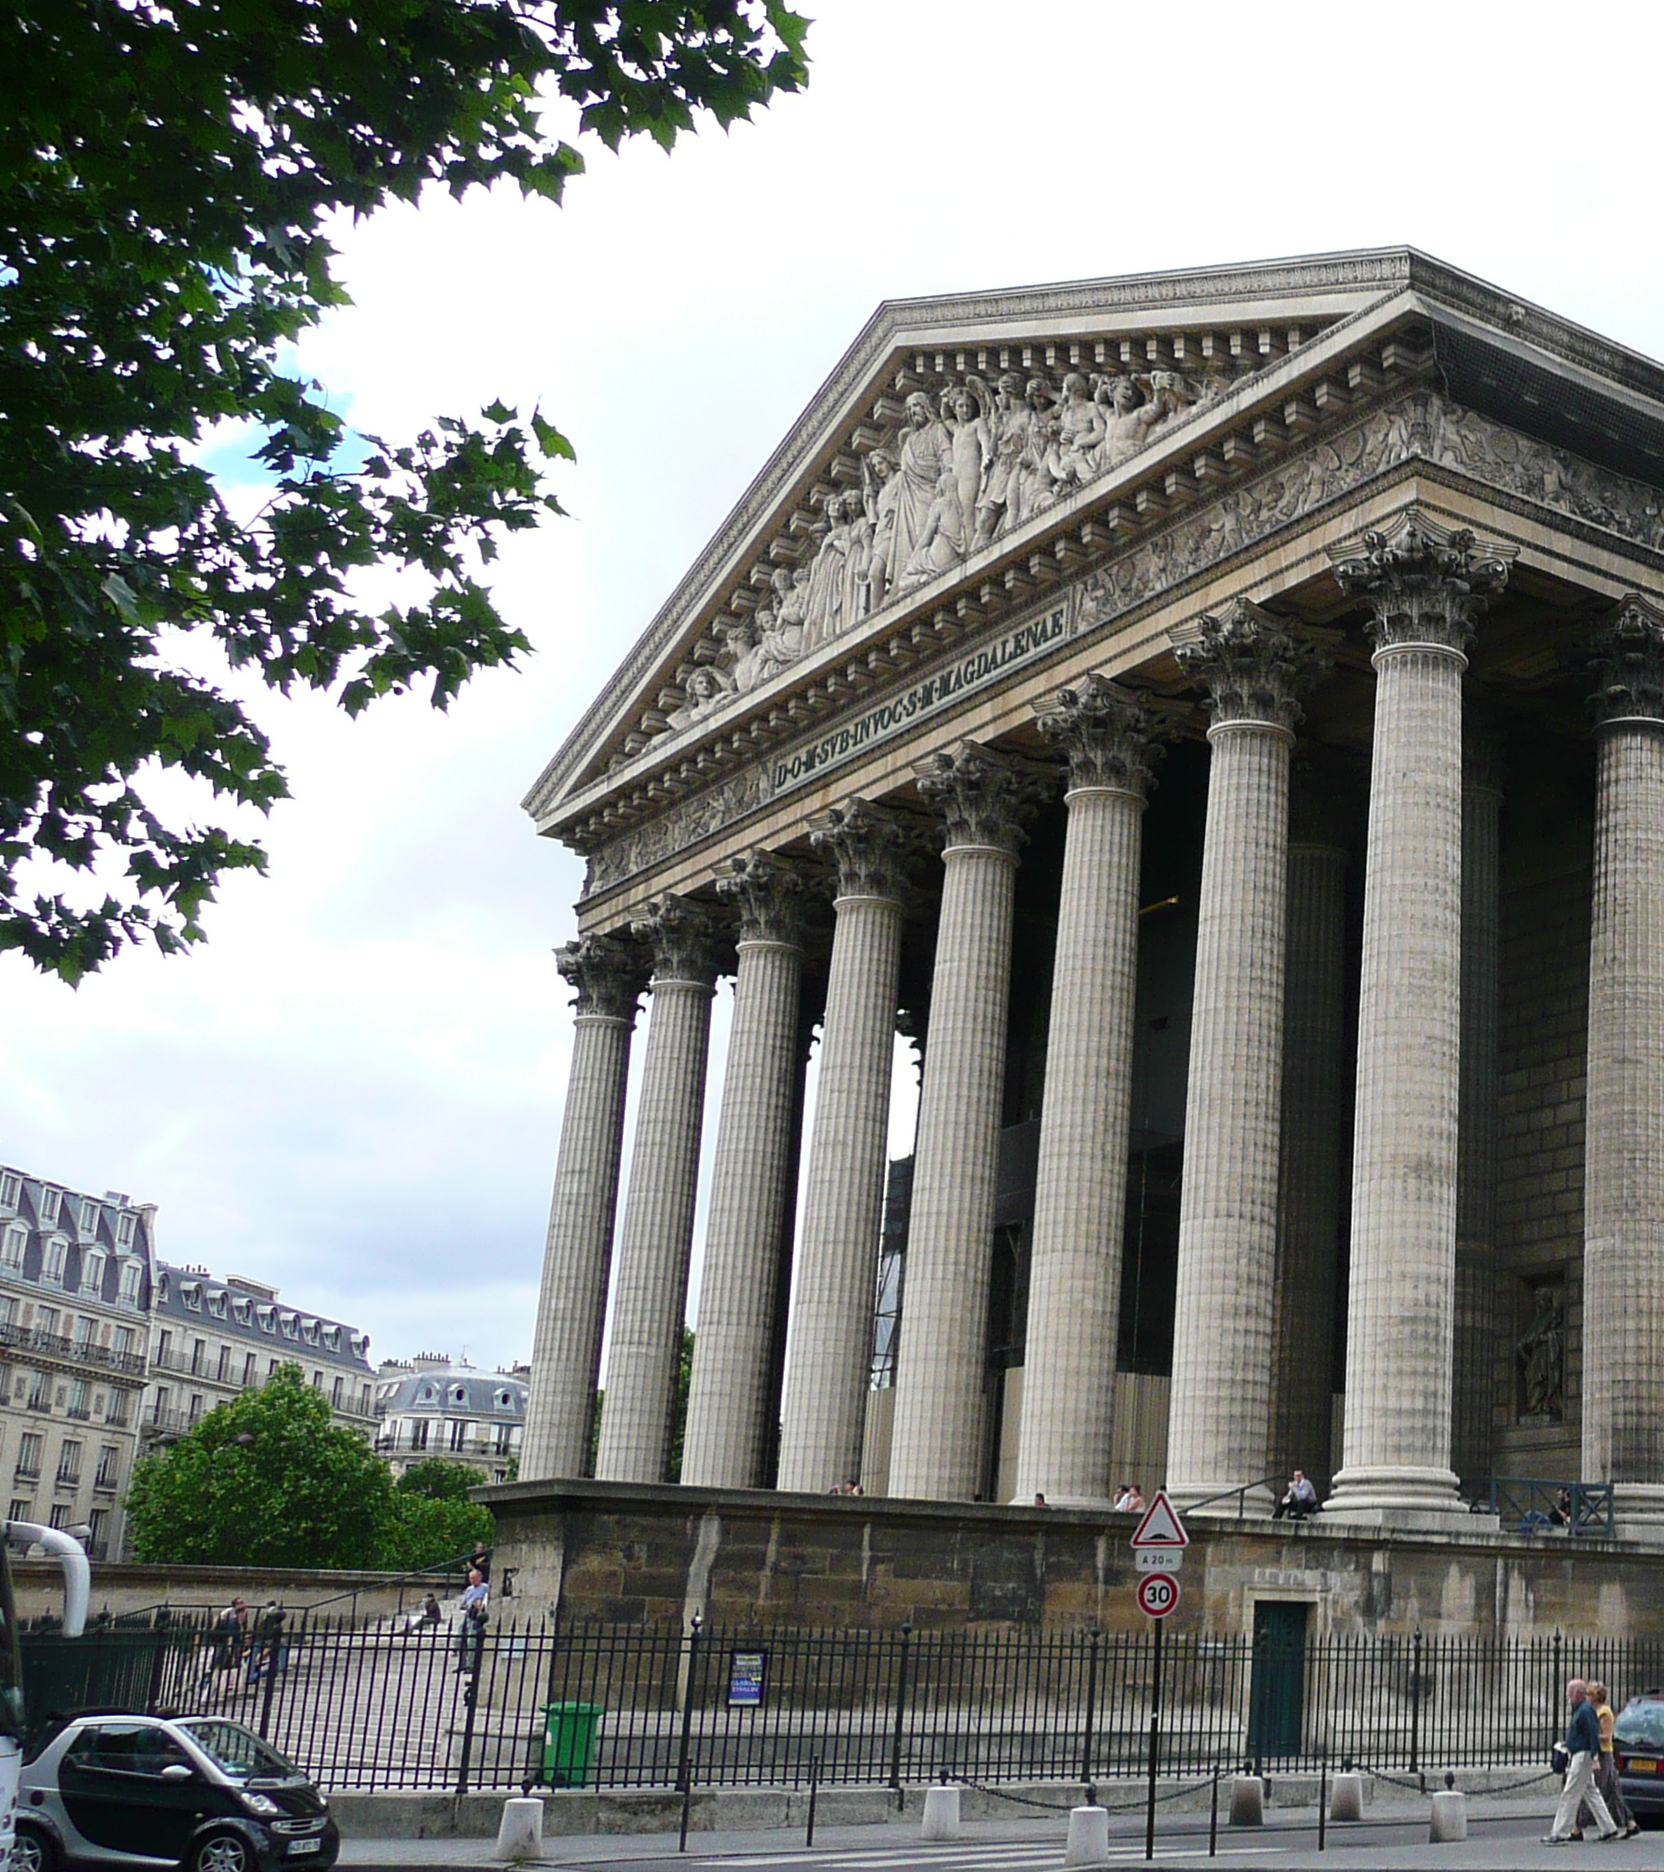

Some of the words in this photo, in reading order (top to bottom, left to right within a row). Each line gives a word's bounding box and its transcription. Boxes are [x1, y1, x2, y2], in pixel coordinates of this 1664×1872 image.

[937, 608, 1063, 701] MAGDALENAE
[1142, 1555, 1148, 1564] A
[1152, 1555, 1164, 1564] 20
[1147, 1586, 1170, 1603] 30
